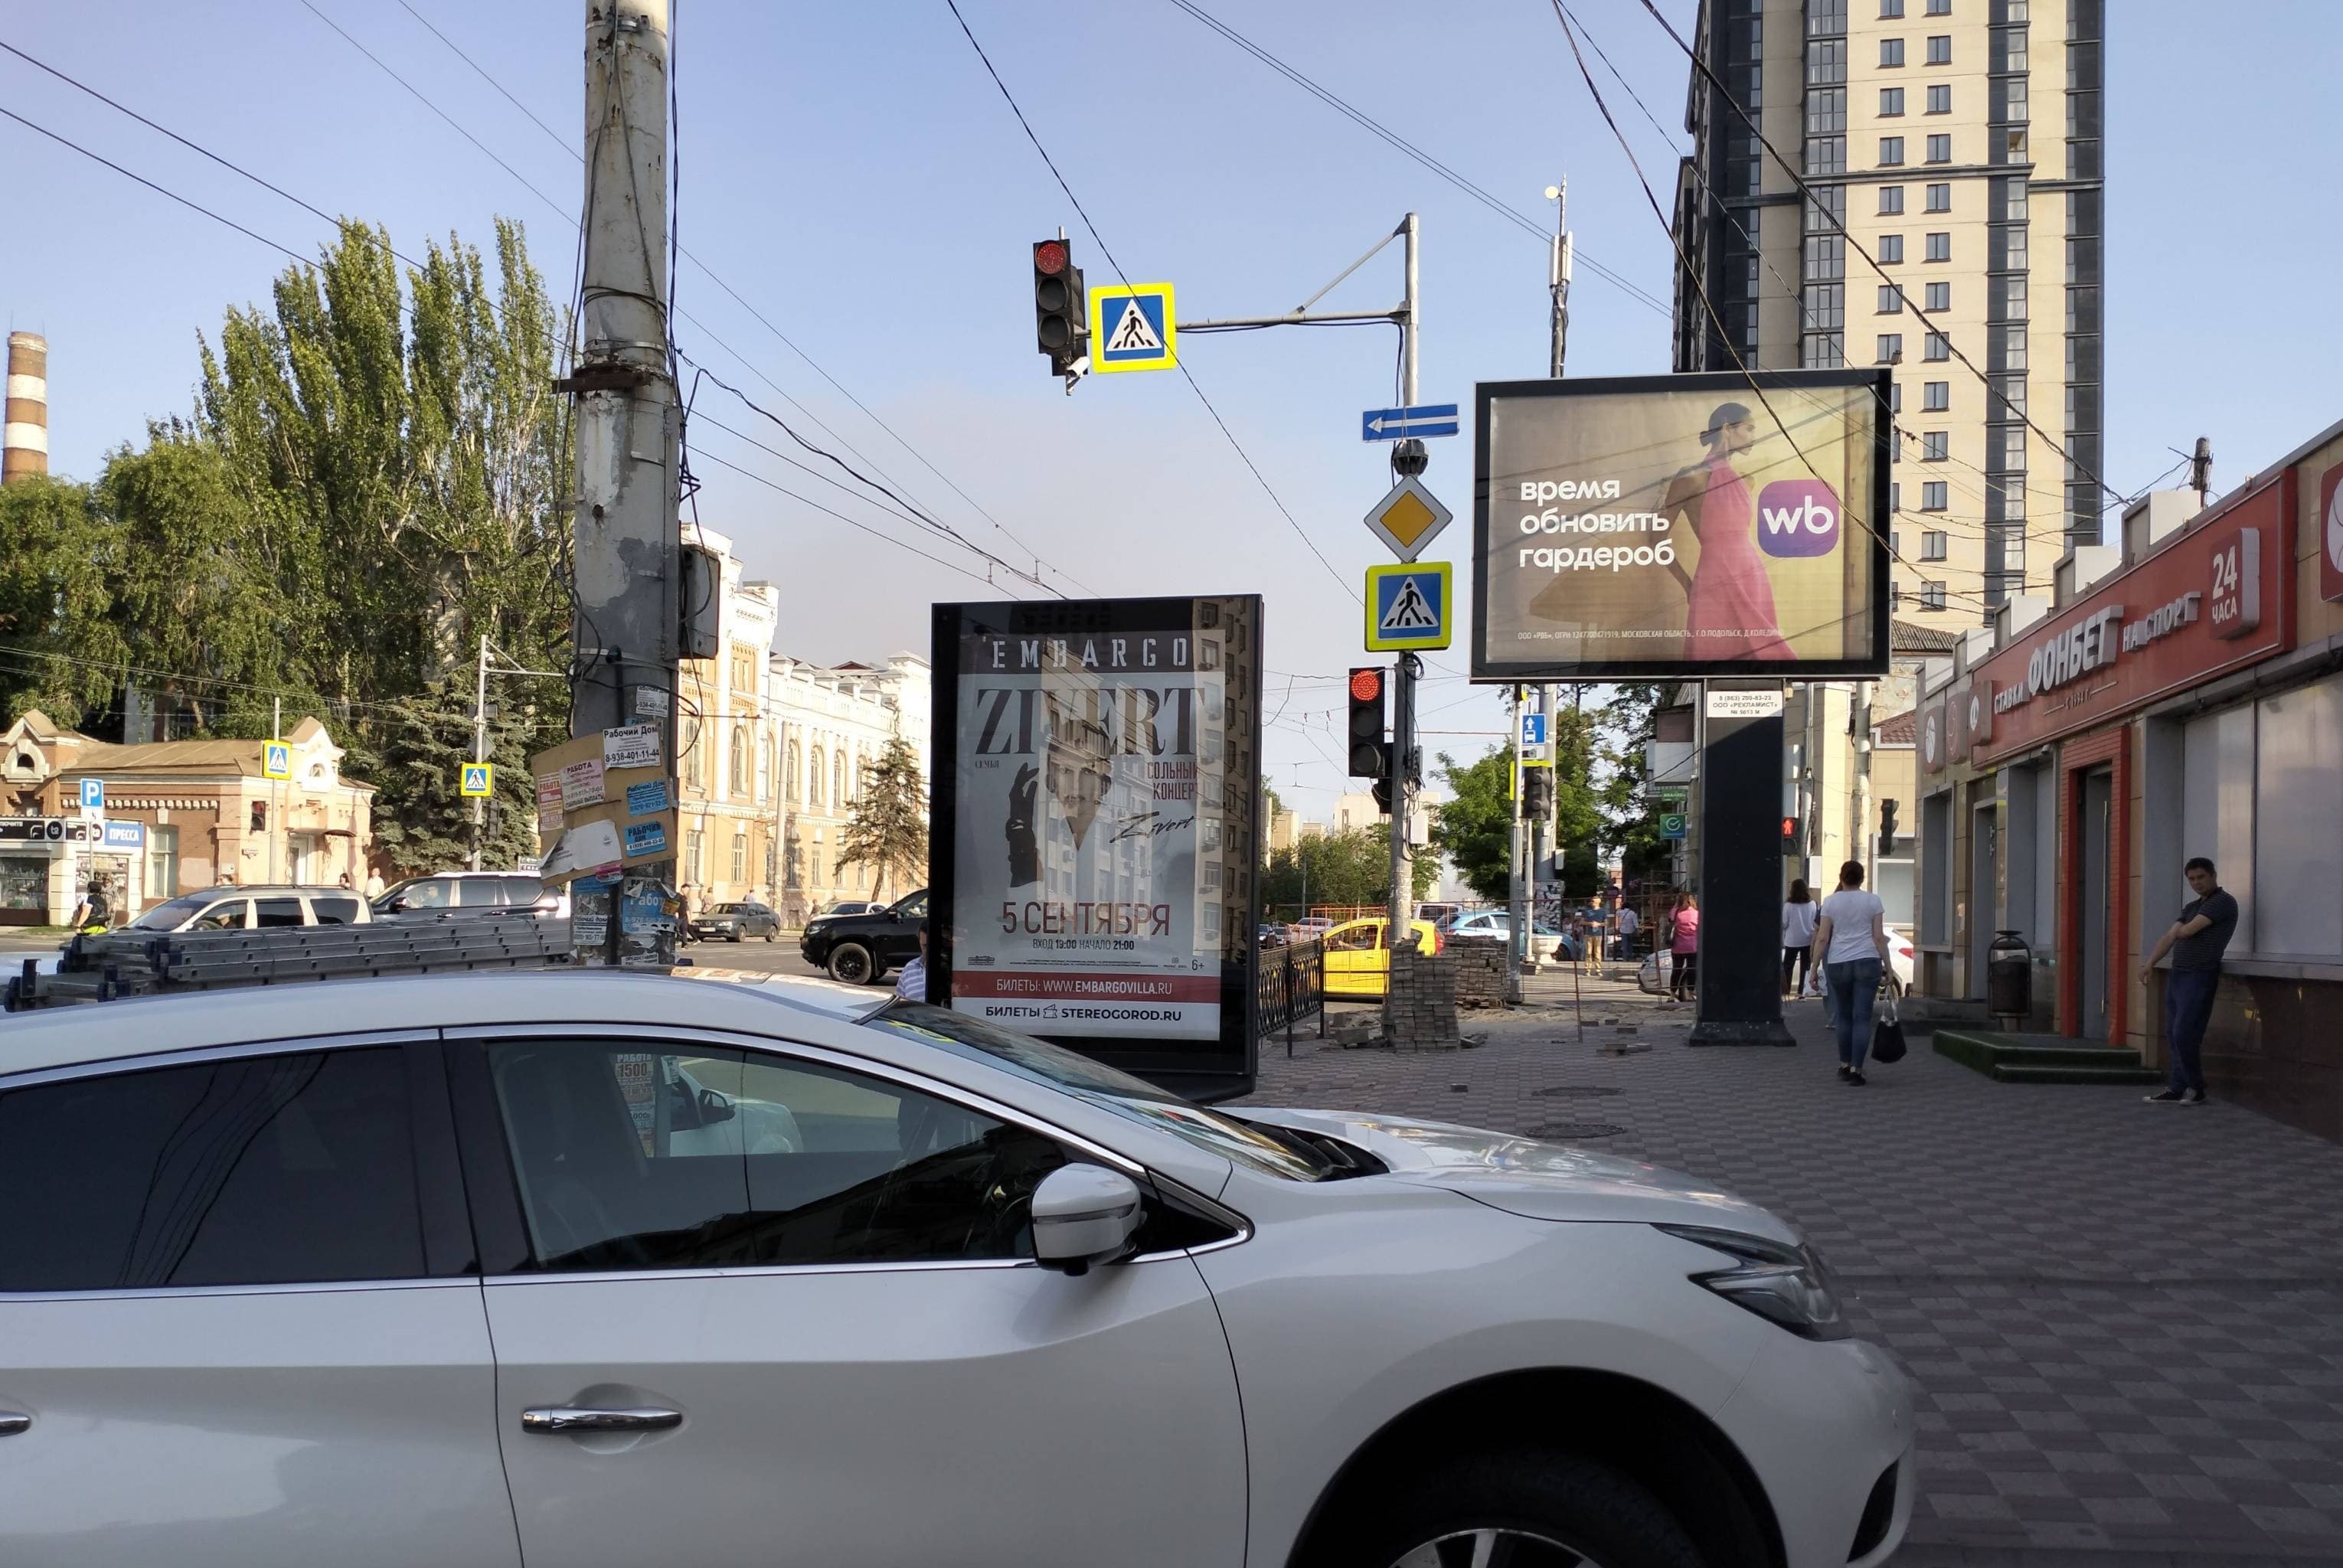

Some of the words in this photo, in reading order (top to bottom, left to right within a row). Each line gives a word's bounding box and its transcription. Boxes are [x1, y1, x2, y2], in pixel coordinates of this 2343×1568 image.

[1520, 479, 1620, 506] время
[1520, 507, 1669, 534] обновить
[1763, 495, 1835, 534] wb
[1519, 538, 1675, 573] гардероб
[2212, 545, 2237, 599] 24
[2211, 597, 2237, 625] ЧАСА
[1518, 632, 1532, 640] ООО
[1554, 630, 1570, 639] ОГРН
[1621, 629, 1662, 639] МОСКОВСКАЯ
[992, 637, 1187, 668] EMBARGO
[1994, 681, 2026, 715] СТАВКИ
[2028, 605, 2124, 696] ФОНБЕТ
[2122, 620, 2145, 653] НА
[2145, 591, 2201, 640] СПОРТ
[641, 726, 658, 736] Дом
[605, 749, 660, 763] 8-938-401-11-44
[567, 761, 593, 774] РАБОТА
[86, 782, 100, 804] P
[539, 780, 560, 792] РАБОТА
[109, 828, 139, 841] ПРЕССА
[1002, 901, 1017, 934] 5
[1024, 901, 1170, 936] СЕНТЯБРЯ
[1032, 939, 1054, 950] ВХОД
[1055, 939, 1077, 949] 19:00
[1079, 939, 1111, 950] НАЧАЛО
[1113, 940, 1135, 951] 21:00
[1191, 959, 1204, 971] 6+
[996, 978, 1041, 992] БИЛЕТЫ:
[1043, 980, 1172, 995] WWW.EMBARGOVILLA.RU
[985, 1006, 1040, 1018] БИЛЕТЫ
[1061, 1008, 1181, 1022] STEREOGOROD.RU
[616, 1054, 652, 1063] РАБОТА
[619, 1063, 648, 1078] 1500
